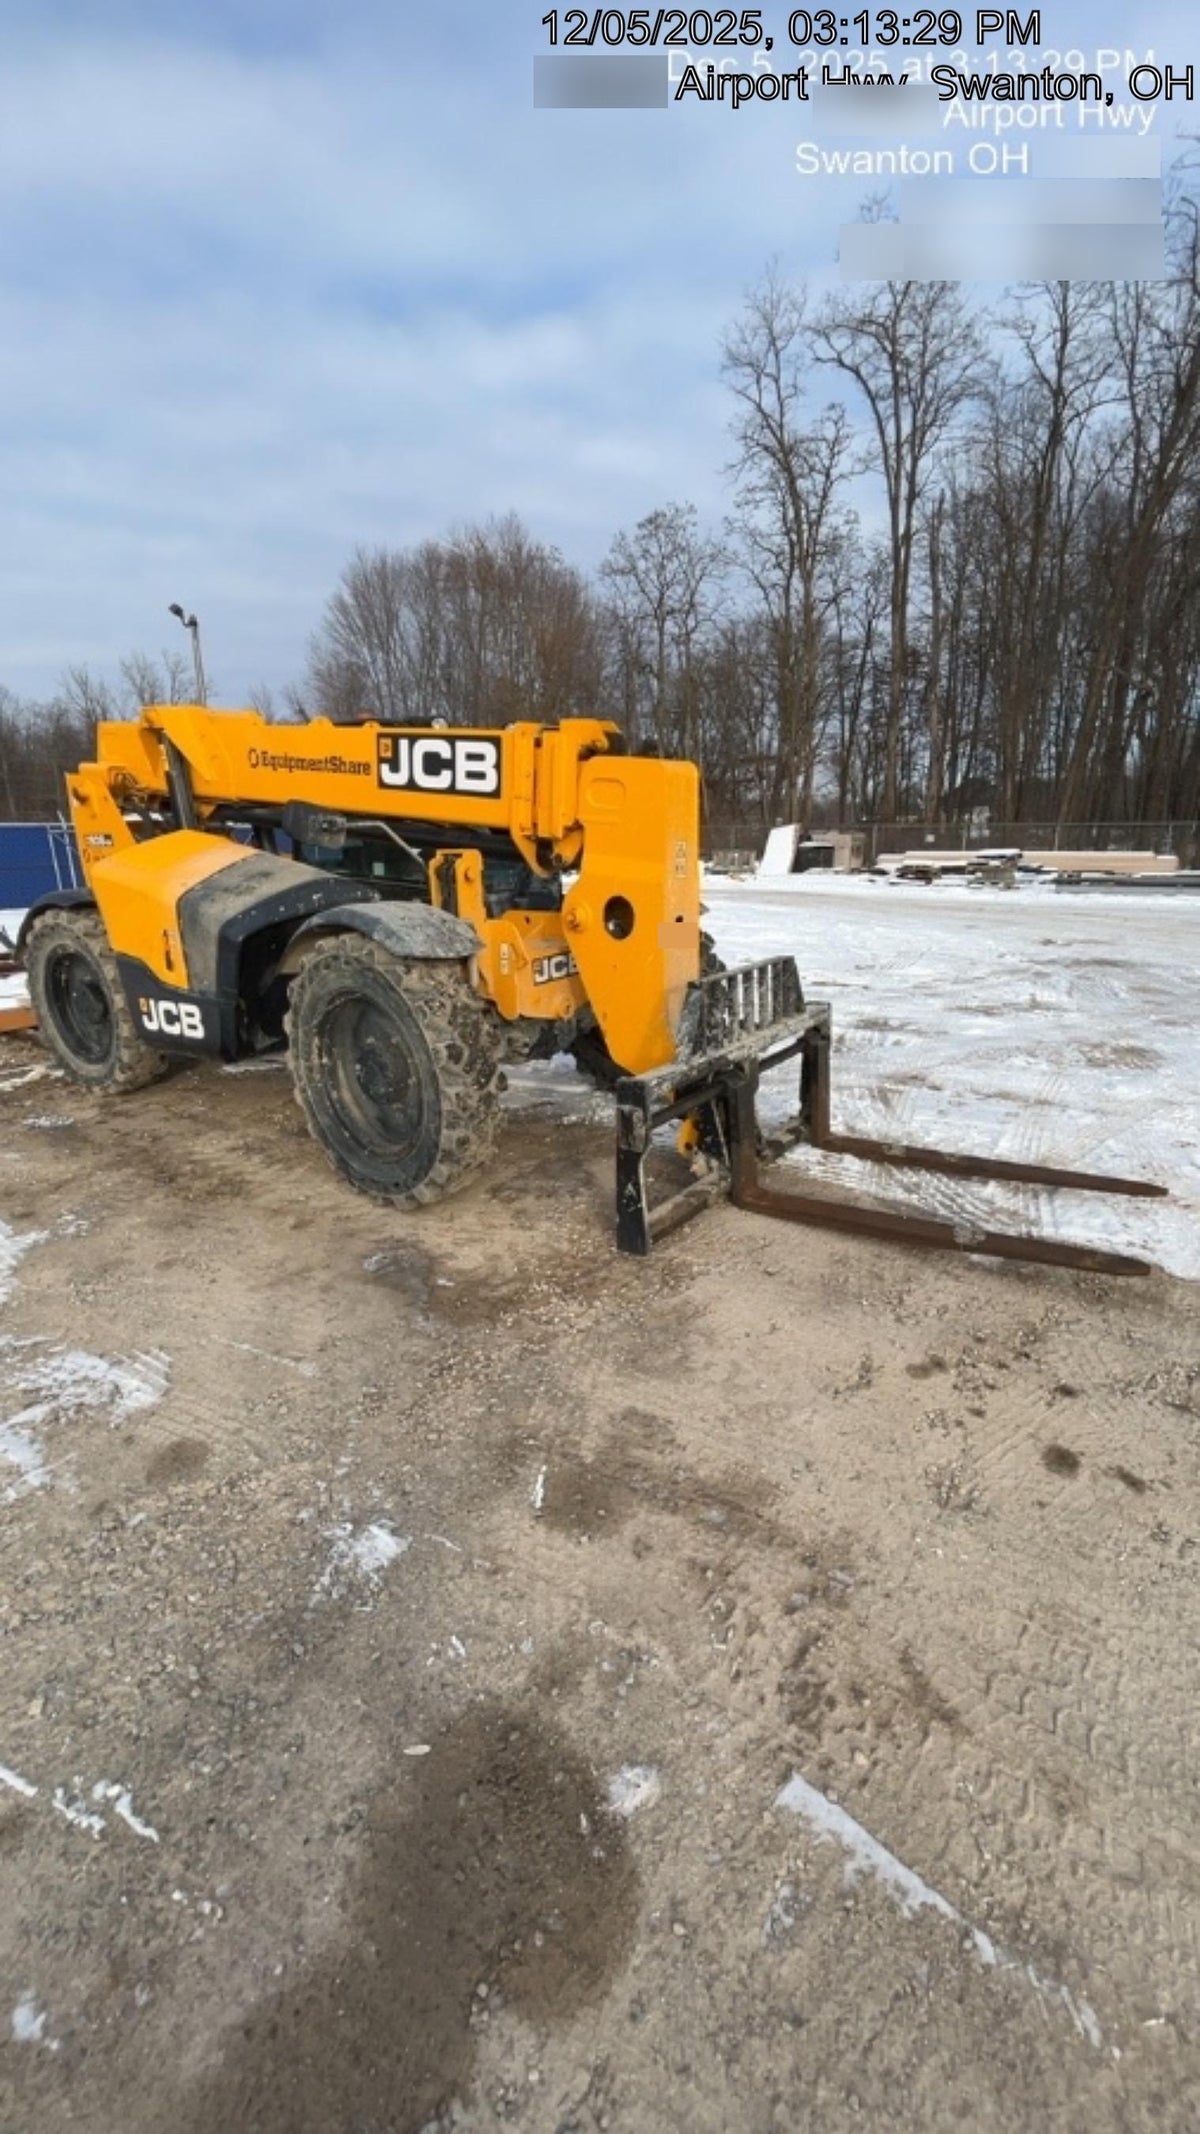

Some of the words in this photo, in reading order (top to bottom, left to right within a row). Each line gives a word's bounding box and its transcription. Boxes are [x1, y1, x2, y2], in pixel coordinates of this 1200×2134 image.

[260, 750, 371, 776] EquipmentShare
[380, 738, 499, 793] JCB
[140, 997, 205, 1039] JCB
